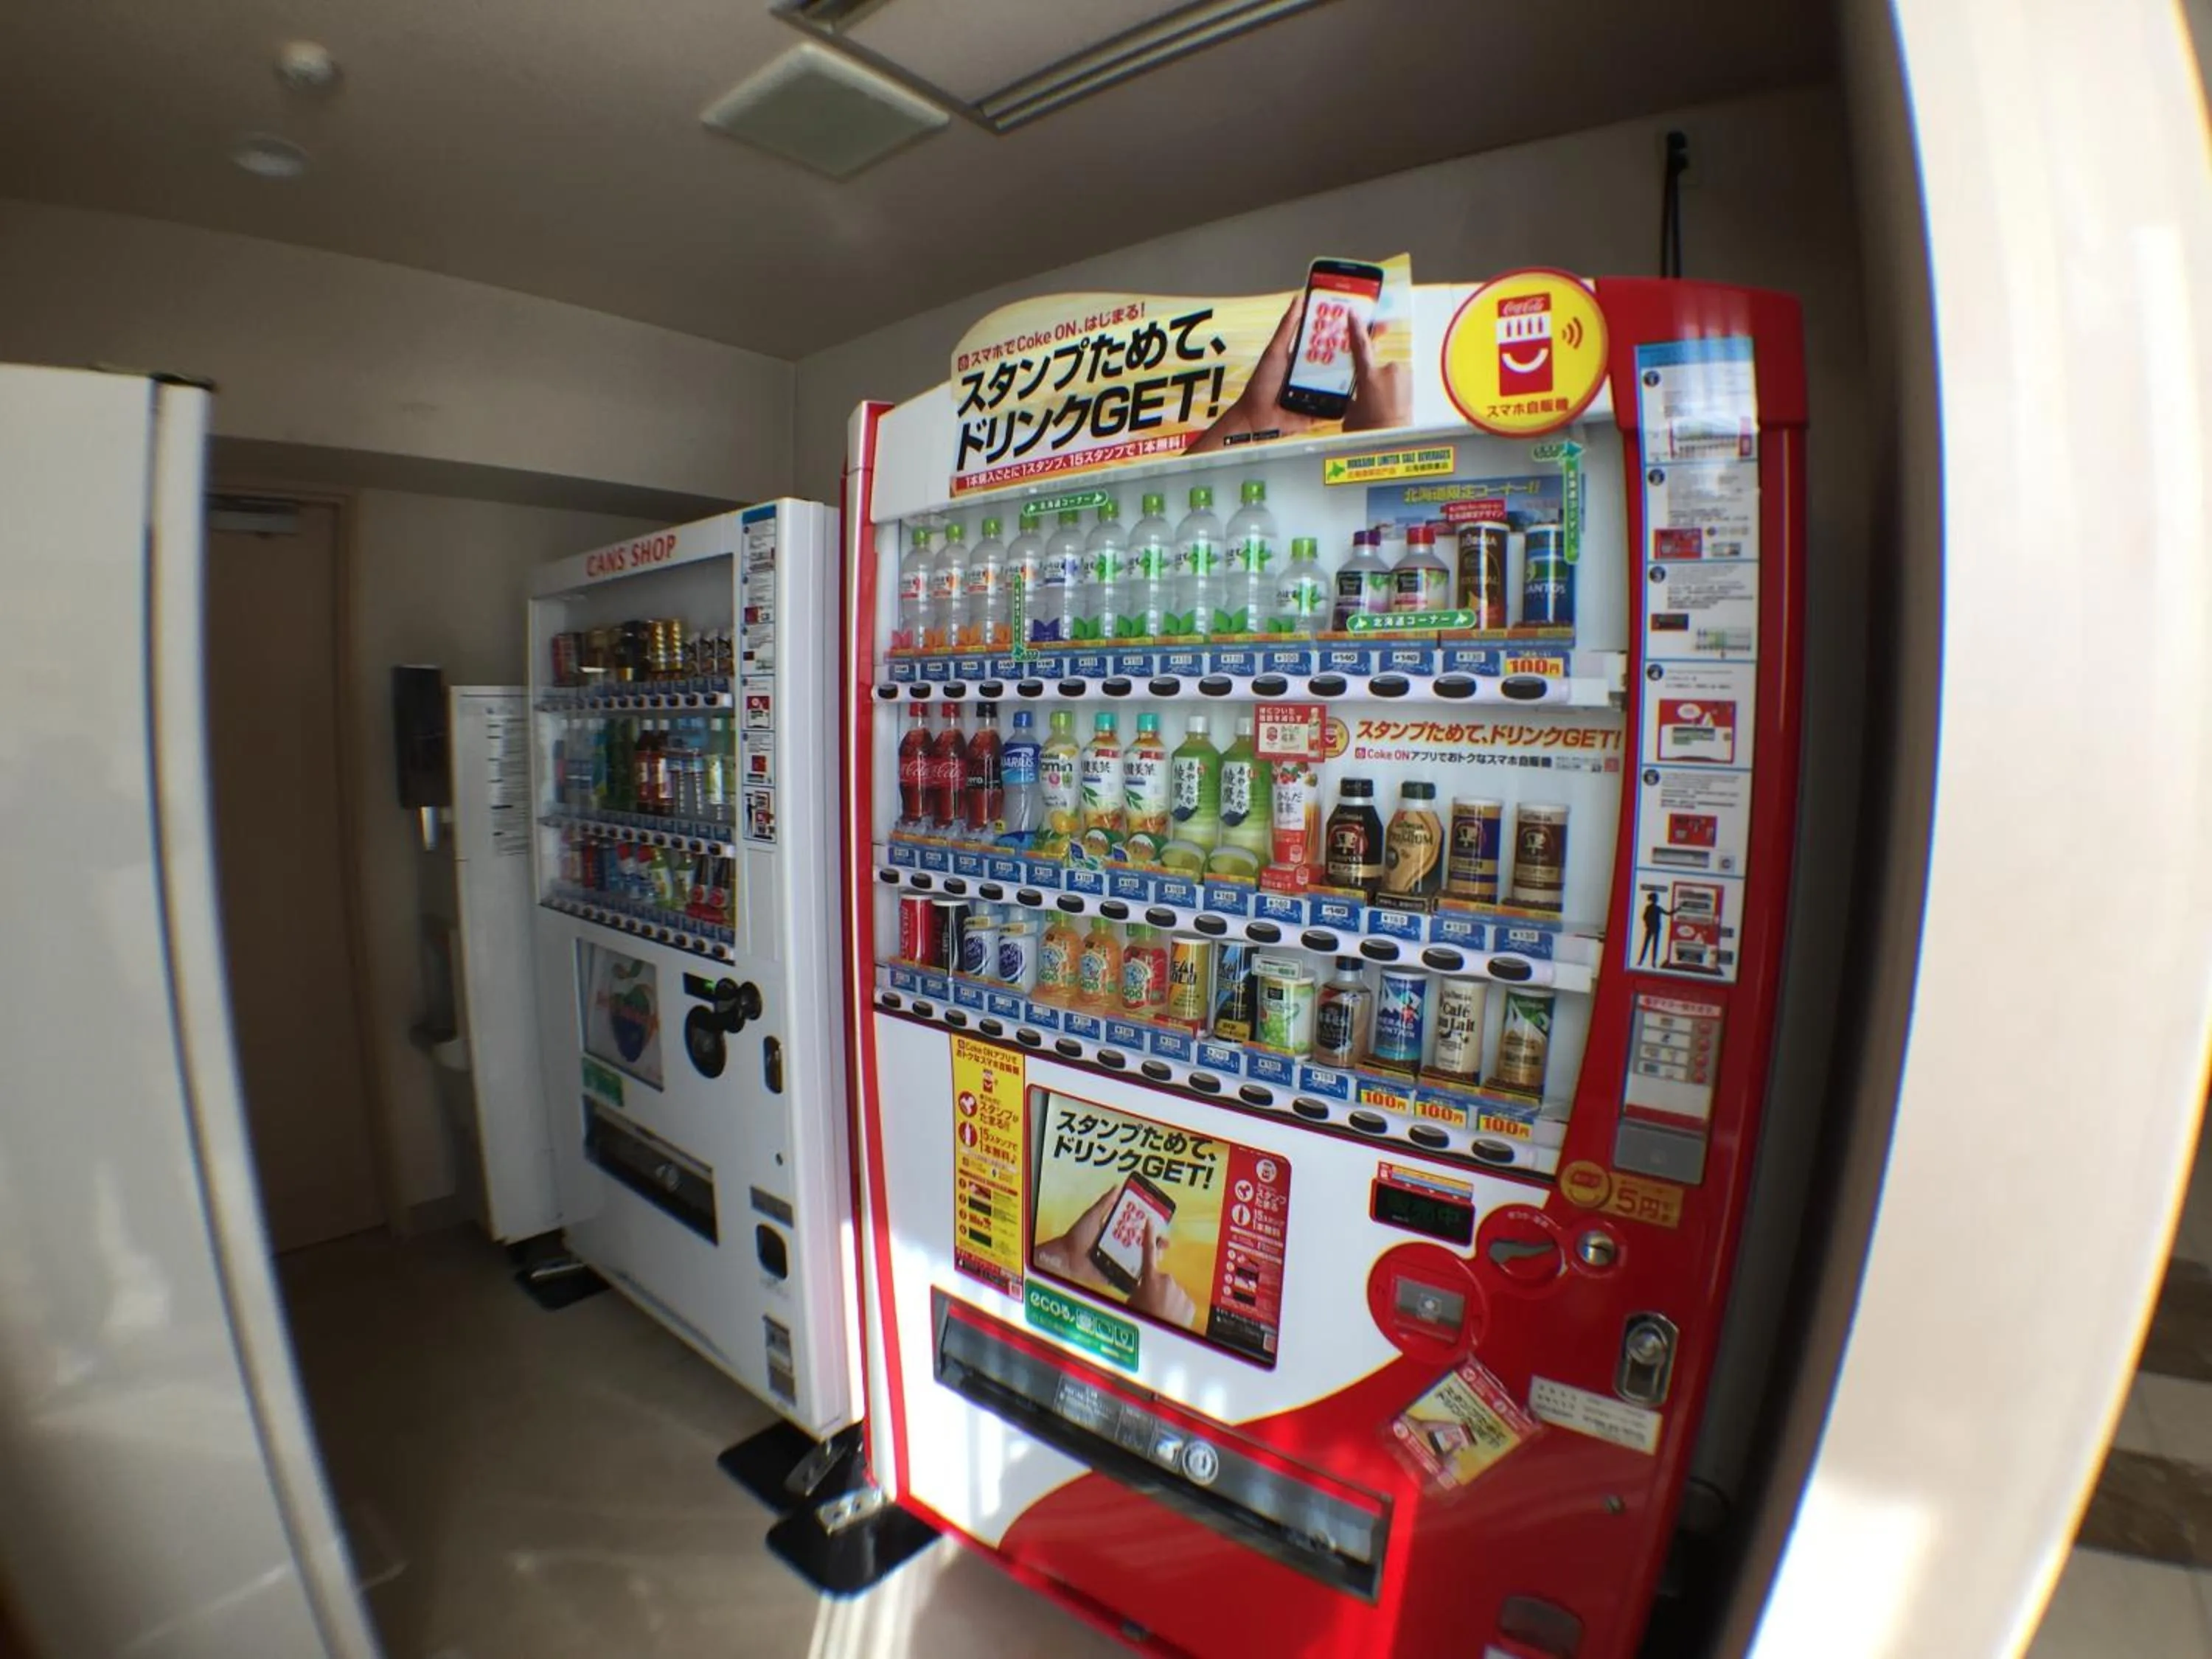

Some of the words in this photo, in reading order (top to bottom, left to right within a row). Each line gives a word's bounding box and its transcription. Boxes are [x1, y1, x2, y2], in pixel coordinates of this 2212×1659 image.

[958, 307, 1227, 417] スタンプためて、
[956, 366, 1223, 470] ドリンクGET!
[585, 549, 625, 577] CANS
[631, 534, 677, 567] SHOP
[1509, 658, 1560, 675] 100円
[1357, 720, 1621, 751] スタンプためて、ドリンクGET!
[1367, 748, 1393, 761] Coke
[1057, 1110, 1218, 1162] スタンプためて、
[1054, 1135, 1215, 1190] ドリンクGET!
